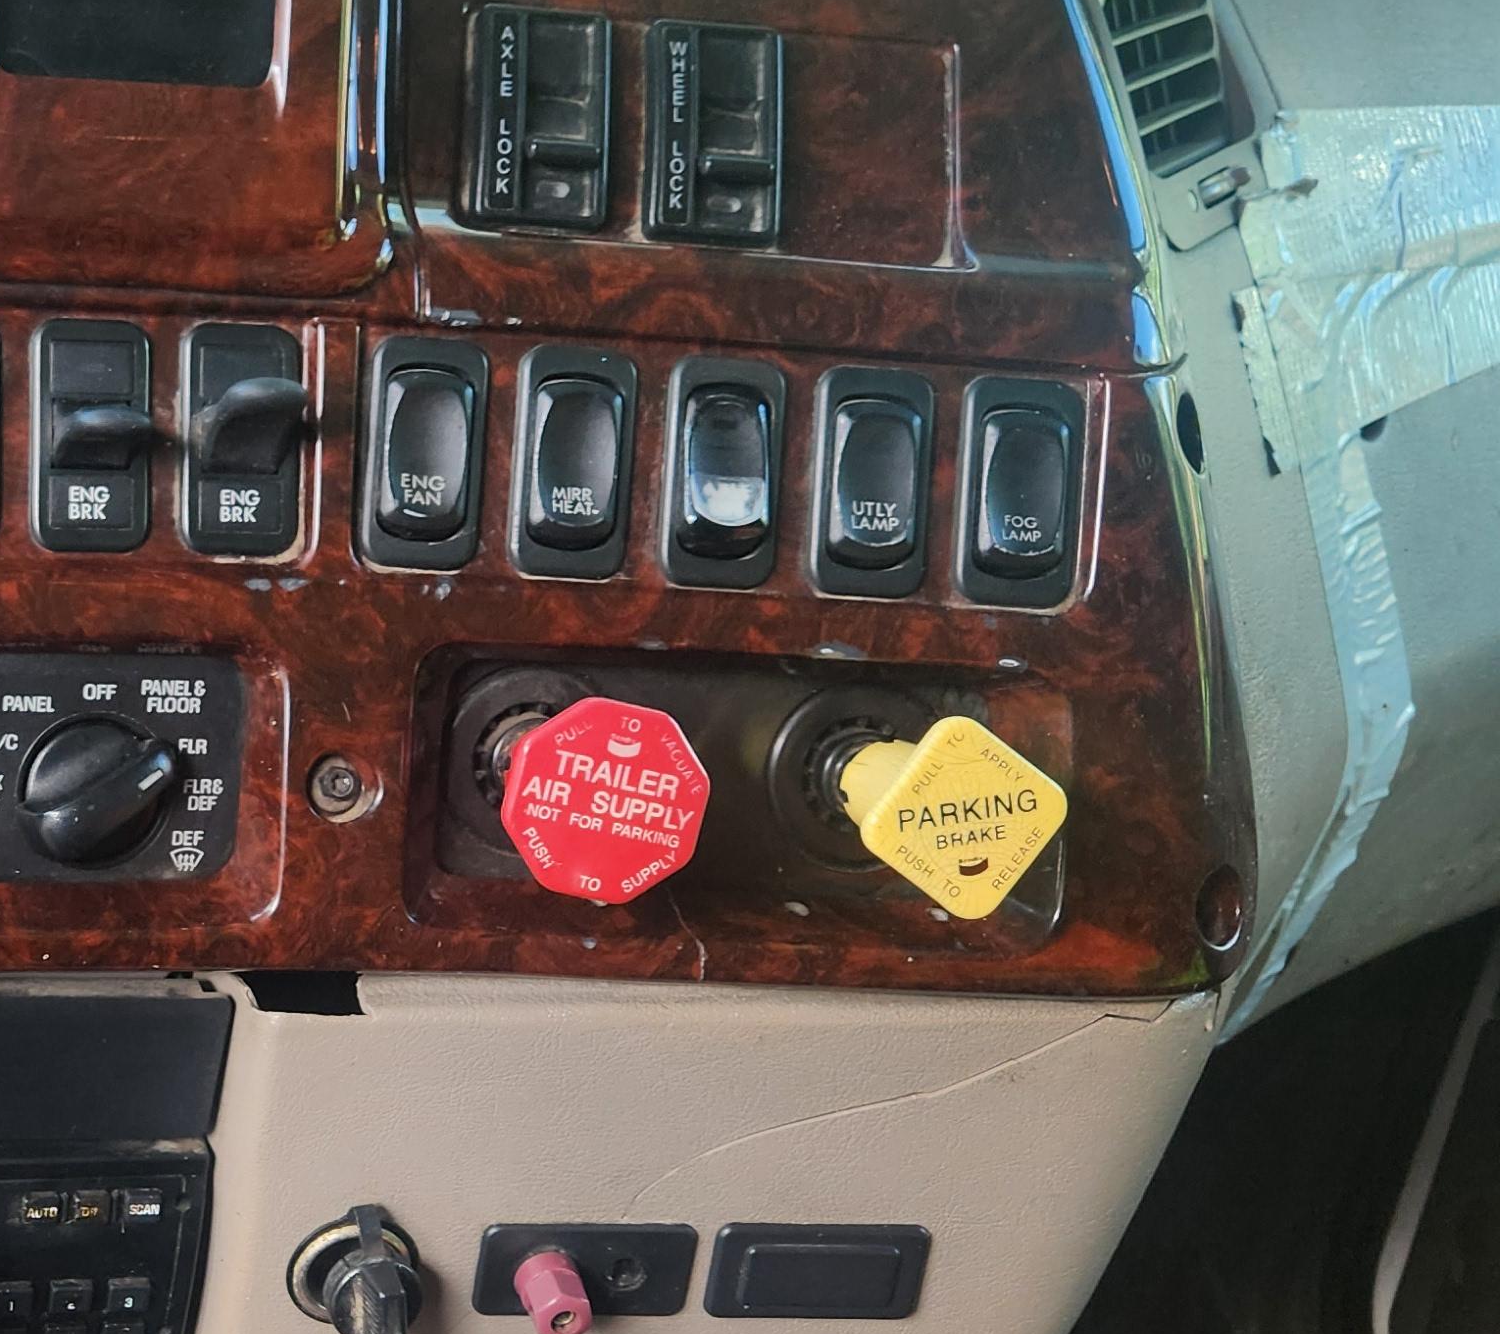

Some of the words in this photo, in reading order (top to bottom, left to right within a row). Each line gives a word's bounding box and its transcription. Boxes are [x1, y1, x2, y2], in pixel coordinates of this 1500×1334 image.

[499, 25, 516, 98] AXLE
[668, 40, 689, 124] WHEEL
[494, 119, 514, 195] LOCK
[668, 141, 686, 210] LOCK
[400, 472, 446, 492] ENG
[67, 485, 111, 505] ENG
[219, 489, 261, 508] ENG
[403, 488, 442, 507] FAN
[551, 485, 593, 502] MIRR
[67, 502, 108, 522] BRK
[219, 505, 258, 524] BRK
[552, 499, 595, 517] HEAT
[852, 500, 897, 519] UTLY
[850, 514, 900, 534] LAMP
[1003, 514, 1037, 530] FOG
[1002, 526, 1042, 544] LAMP
[82, 683, 118, 701] OFF
[2, 695, 56, 713] PANEL
[146, 697, 202, 714] FLOOR
[554, 720, 594, 747] PULL
[178, 738, 208, 755] FLR
[556, 749, 681, 801] TRAILER
[911, 761, 944, 796] PULL
[979, 747, 1024, 784] APPLY
[187, 794, 218, 812] DEF
[522, 776, 572, 807] AIR
[590, 790, 694, 831] SUPPLY
[897, 788, 1038, 833] PARKING
[525, 803, 562, 822] NOT
[569, 812, 604, 832] FOR
[611, 822, 681, 849] PARKING
[171, 830, 205, 847] DEF
[936, 824, 1008, 850] BRAKE
[522, 827, 557, 870] PUSH
[579, 874, 602, 892] TO
[620, 850, 678, 893] SUPPLY
[895, 845, 936, 879] PUSH
[940, 878, 961, 899] TO
[991, 826, 1044, 891] RELEASE
[26, 1207, 59, 1219] AUTO
[128, 1203, 161, 1216] SCAN
[124, 1297, 134, 1308] 3
